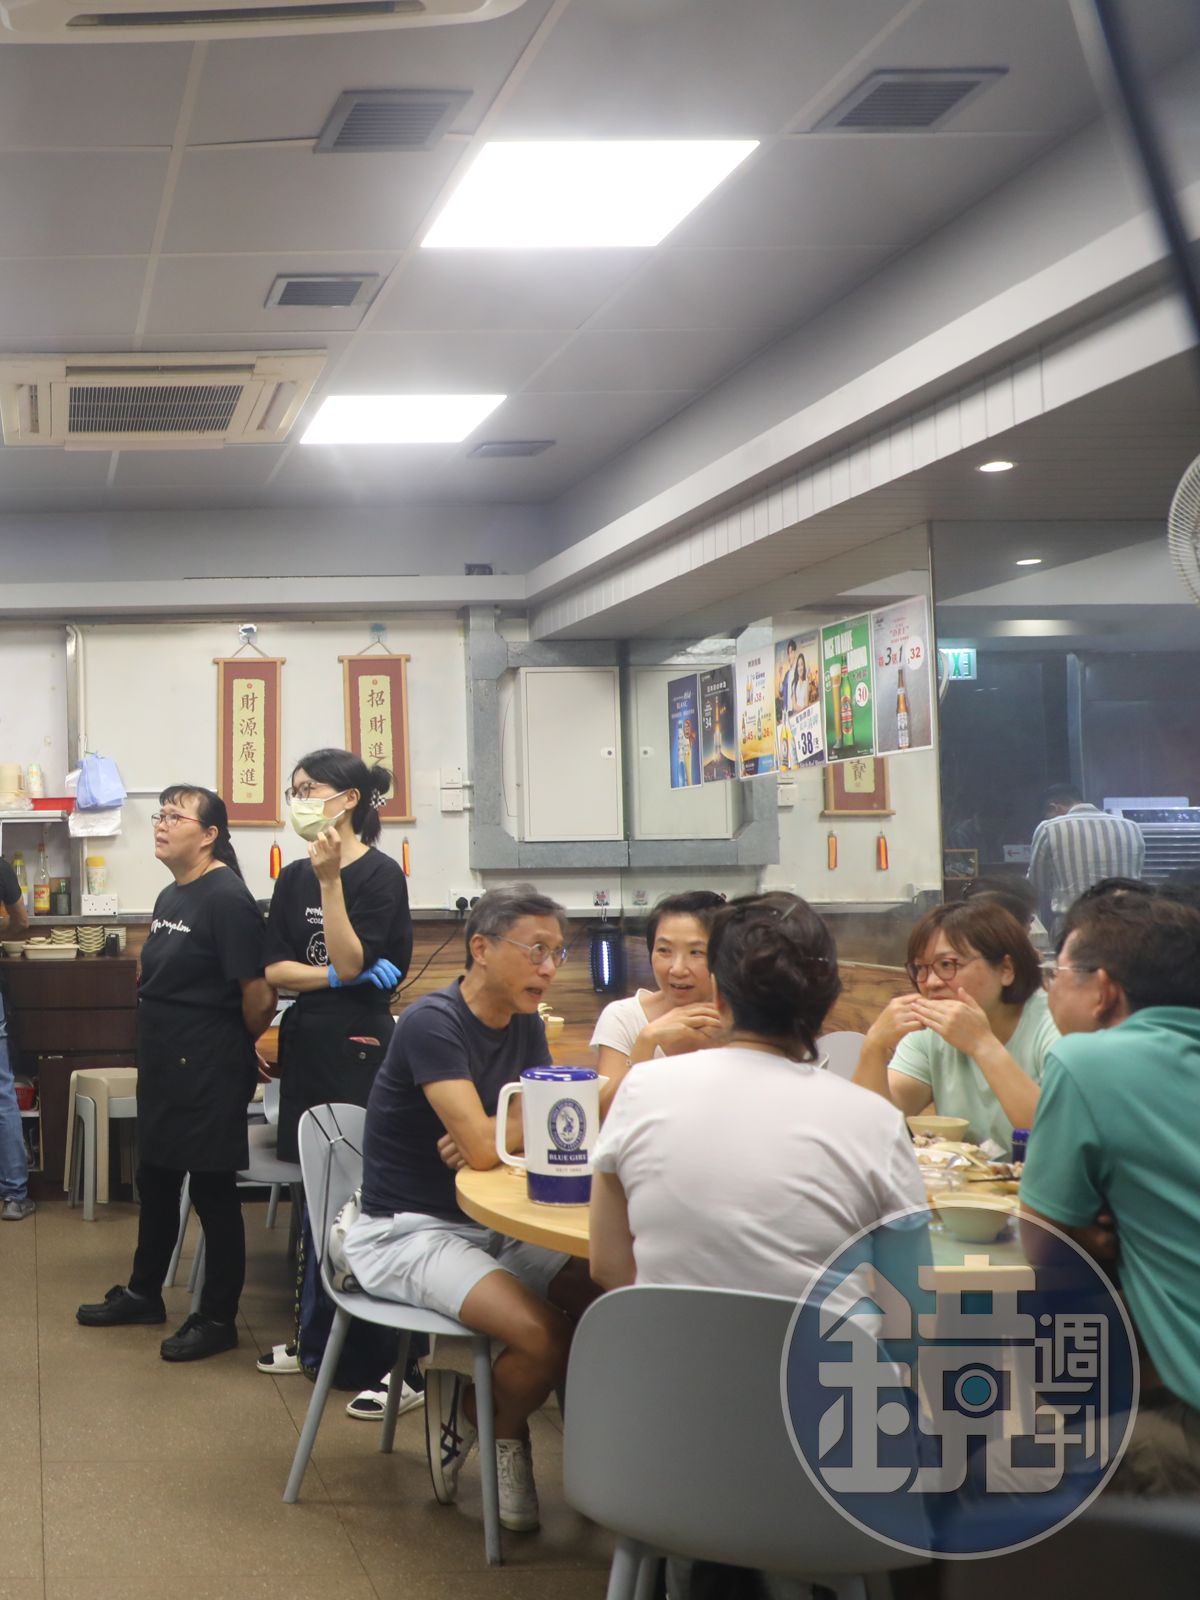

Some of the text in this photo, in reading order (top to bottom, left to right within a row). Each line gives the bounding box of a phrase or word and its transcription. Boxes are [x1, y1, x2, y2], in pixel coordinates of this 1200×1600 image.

[240, 691, 258, 787] 財源廣進
[367, 688, 386, 760] 招財進
[549, 1153, 586, 1161] BLUE GIRL
